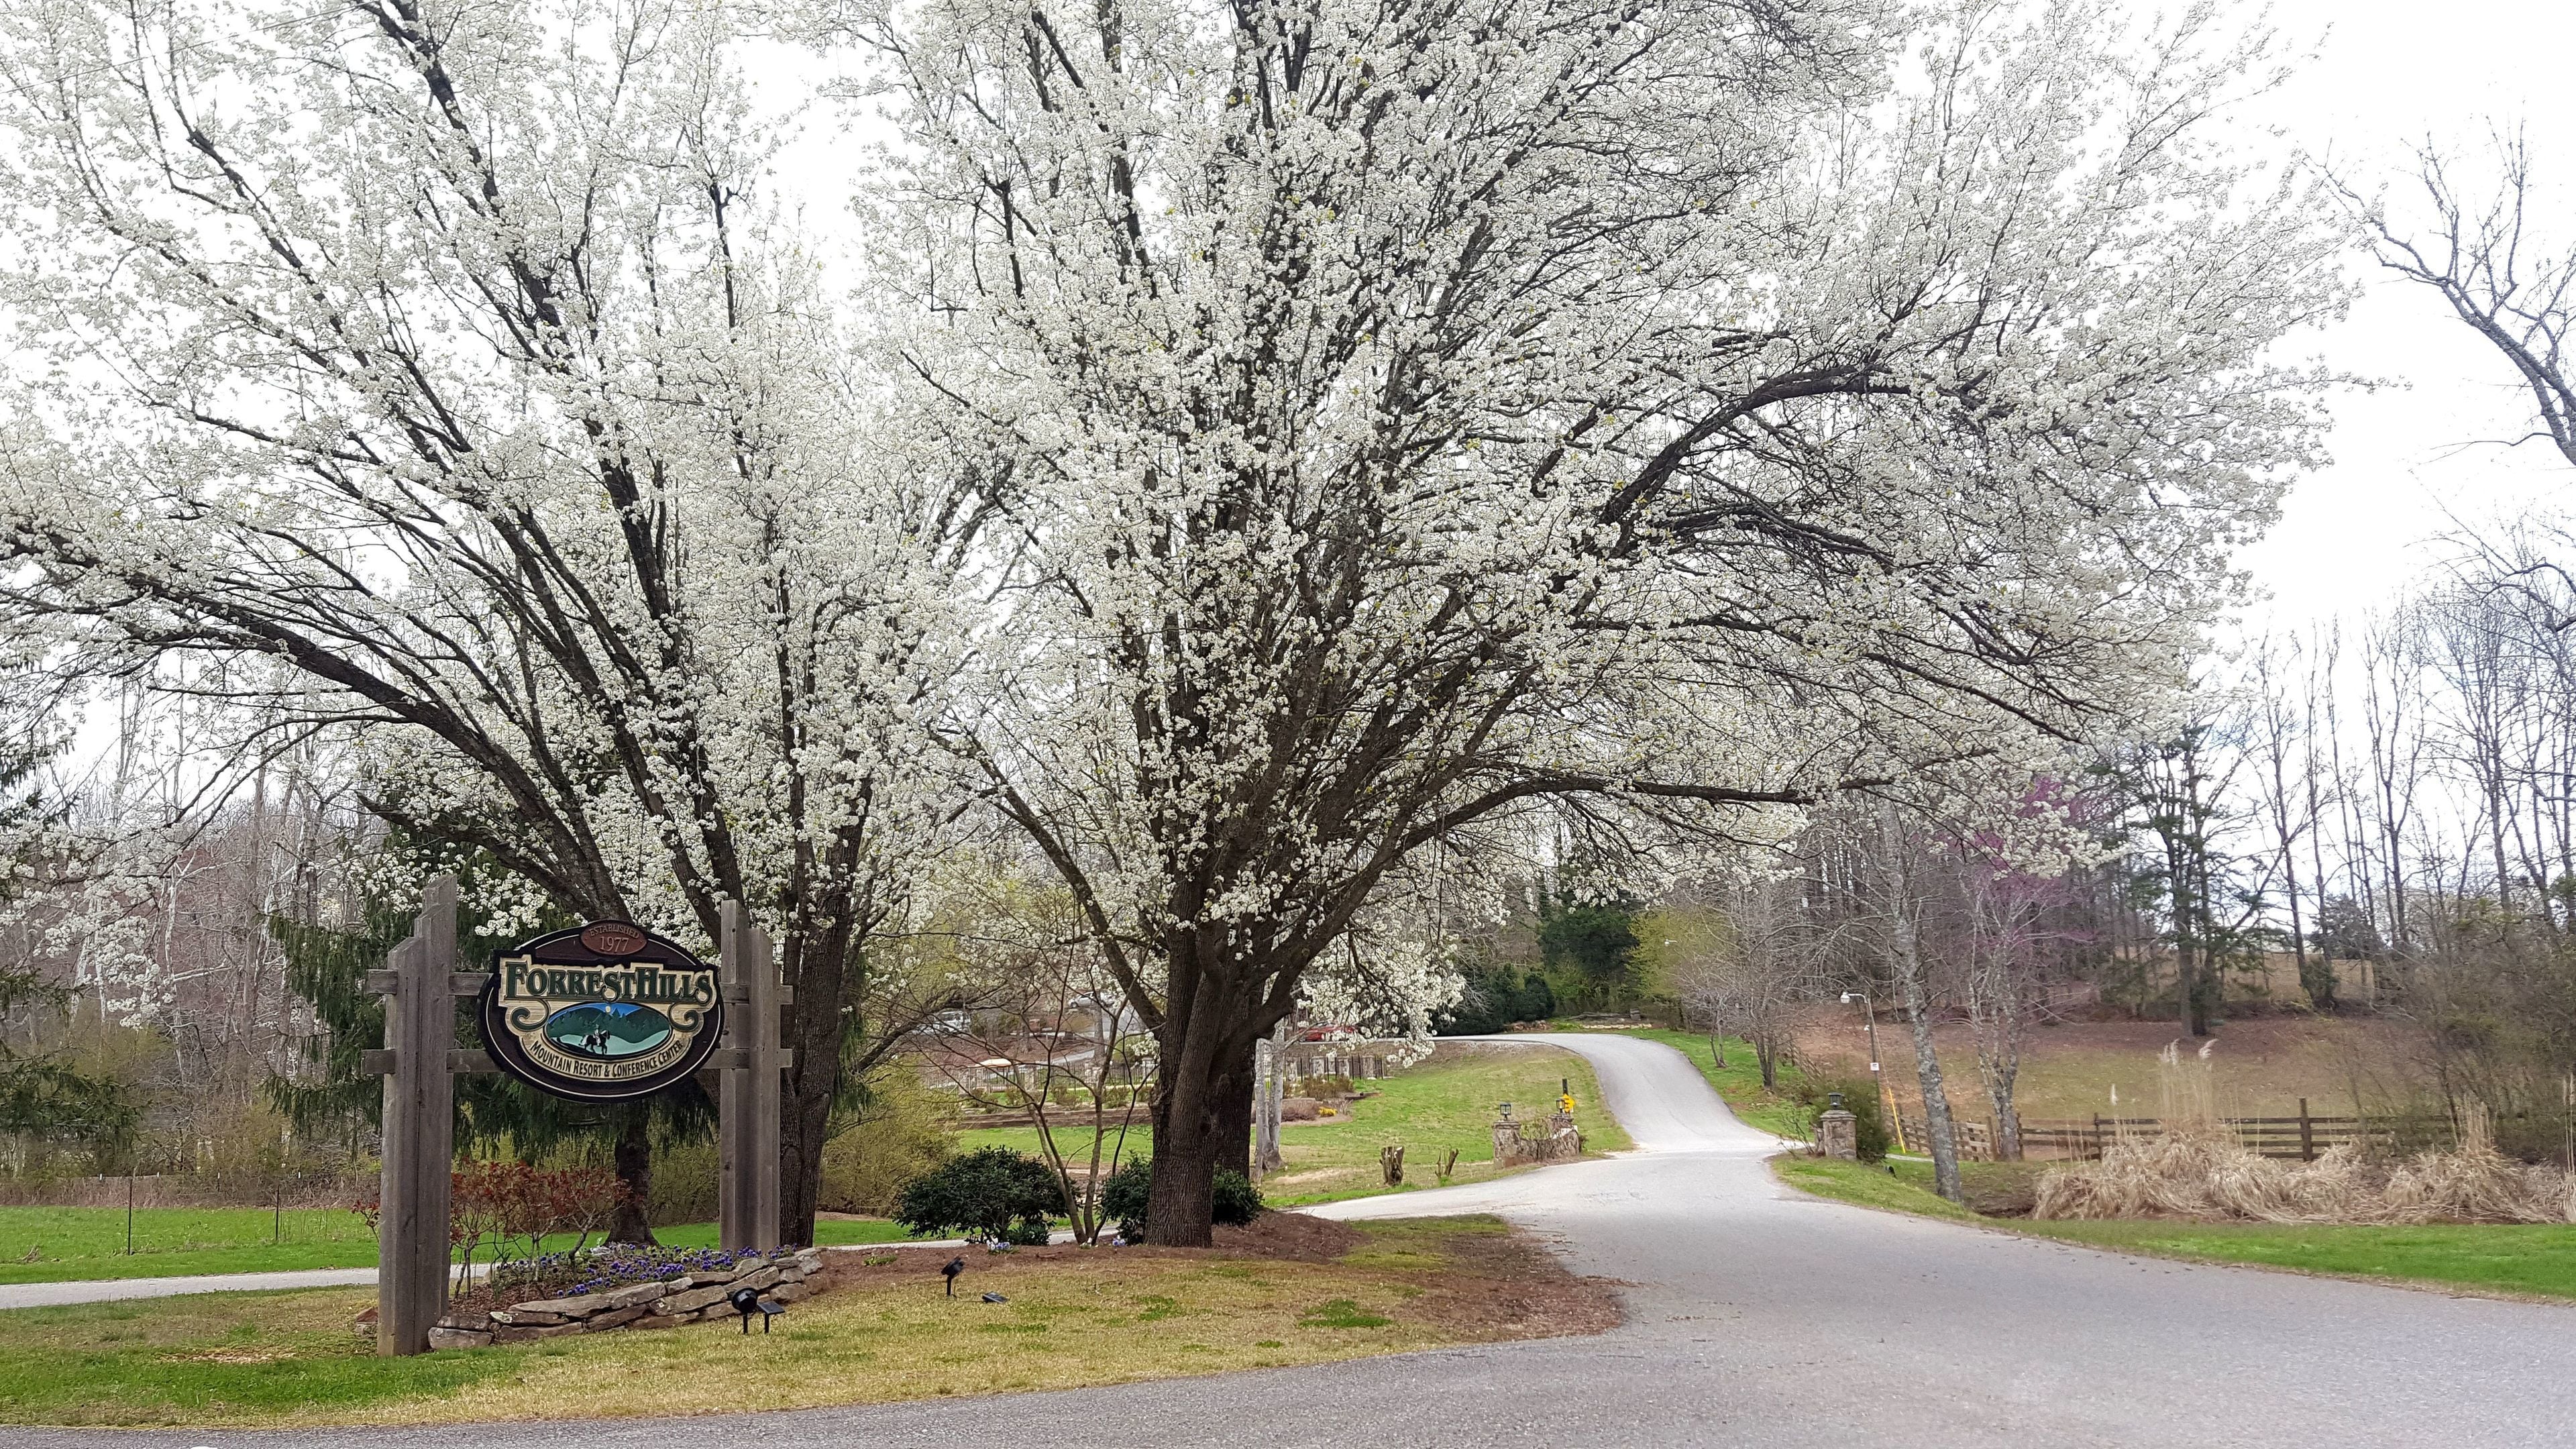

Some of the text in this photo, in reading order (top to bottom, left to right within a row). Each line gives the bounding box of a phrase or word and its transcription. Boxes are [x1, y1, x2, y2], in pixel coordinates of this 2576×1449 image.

[589, 924, 639, 938] ESTABLISHED
[600, 936, 629, 953] 1977
[530, 1040, 683, 1077] MOUNTAIN RESORT & CONFERENCE CENTER
